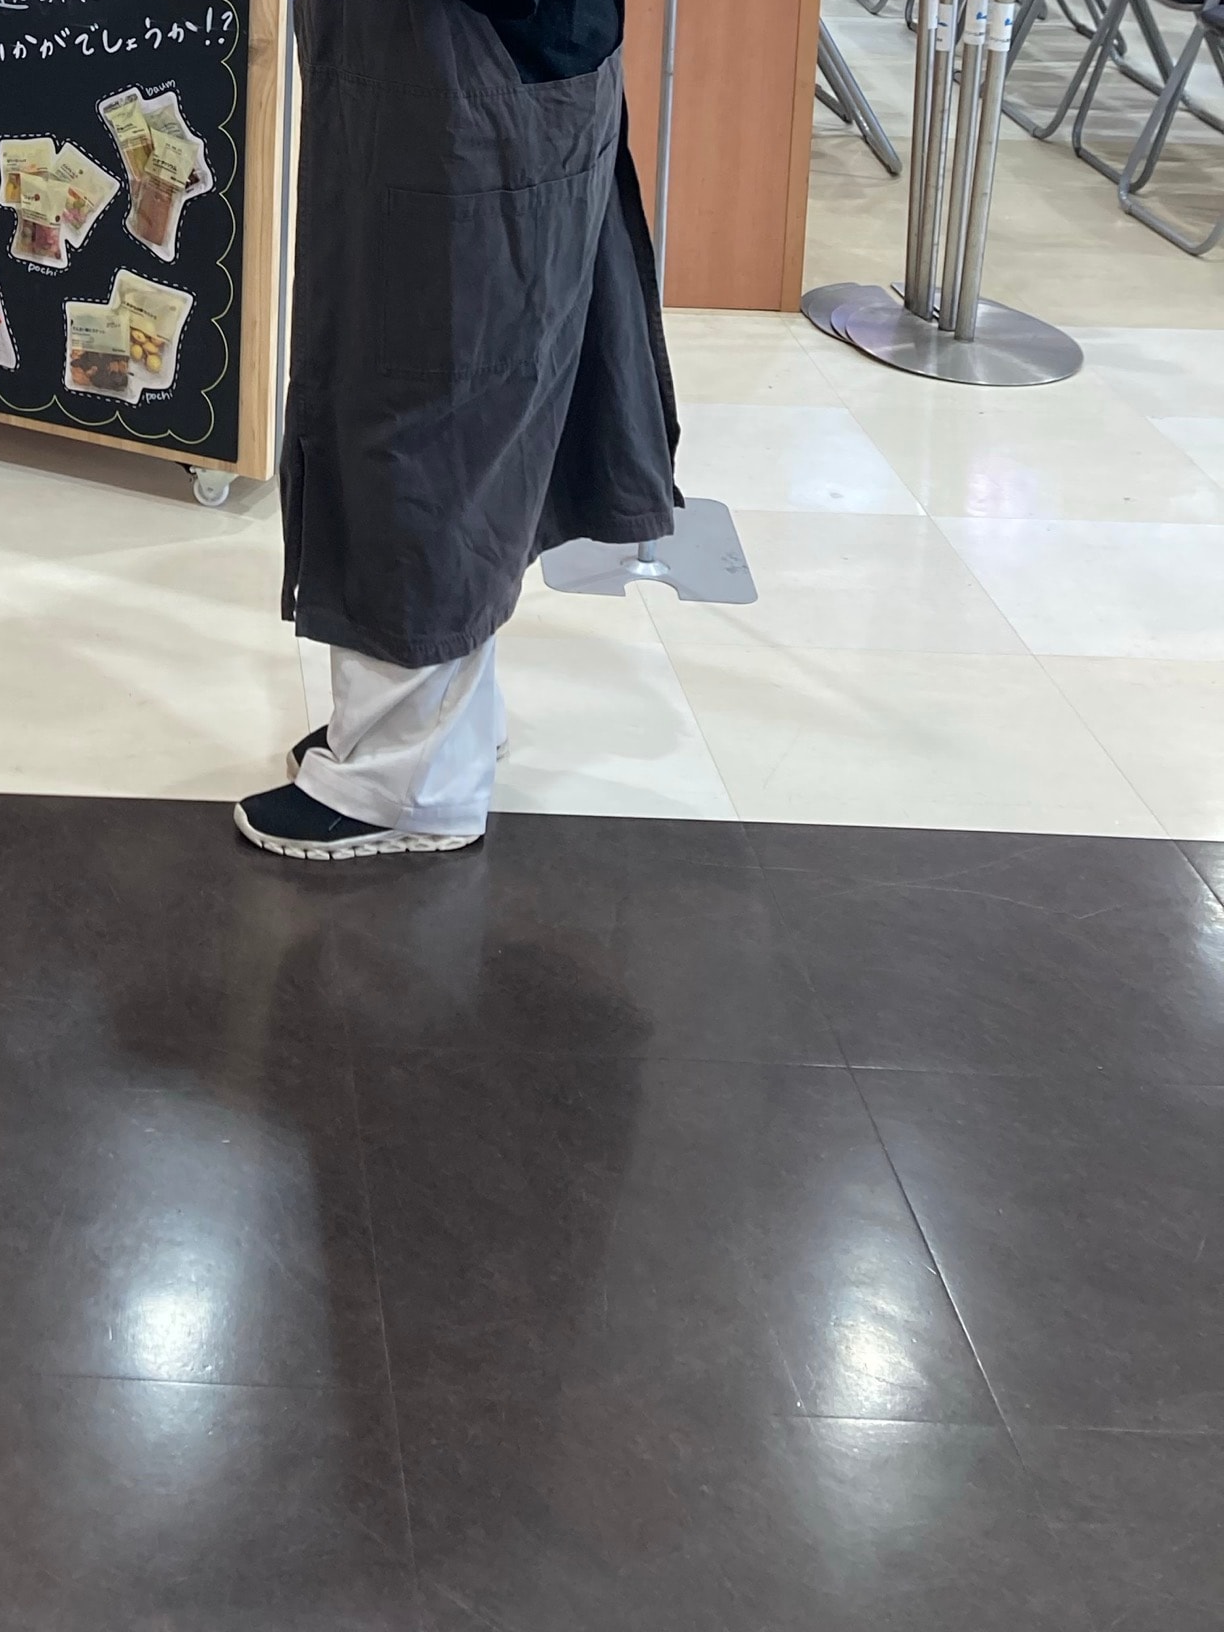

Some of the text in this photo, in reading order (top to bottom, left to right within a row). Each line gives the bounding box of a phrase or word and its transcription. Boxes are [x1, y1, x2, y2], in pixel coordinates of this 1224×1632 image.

[145, 79, 177, 97] baum
[27, 263, 57, 277] pochi
[146, 390, 174, 404] pochi
